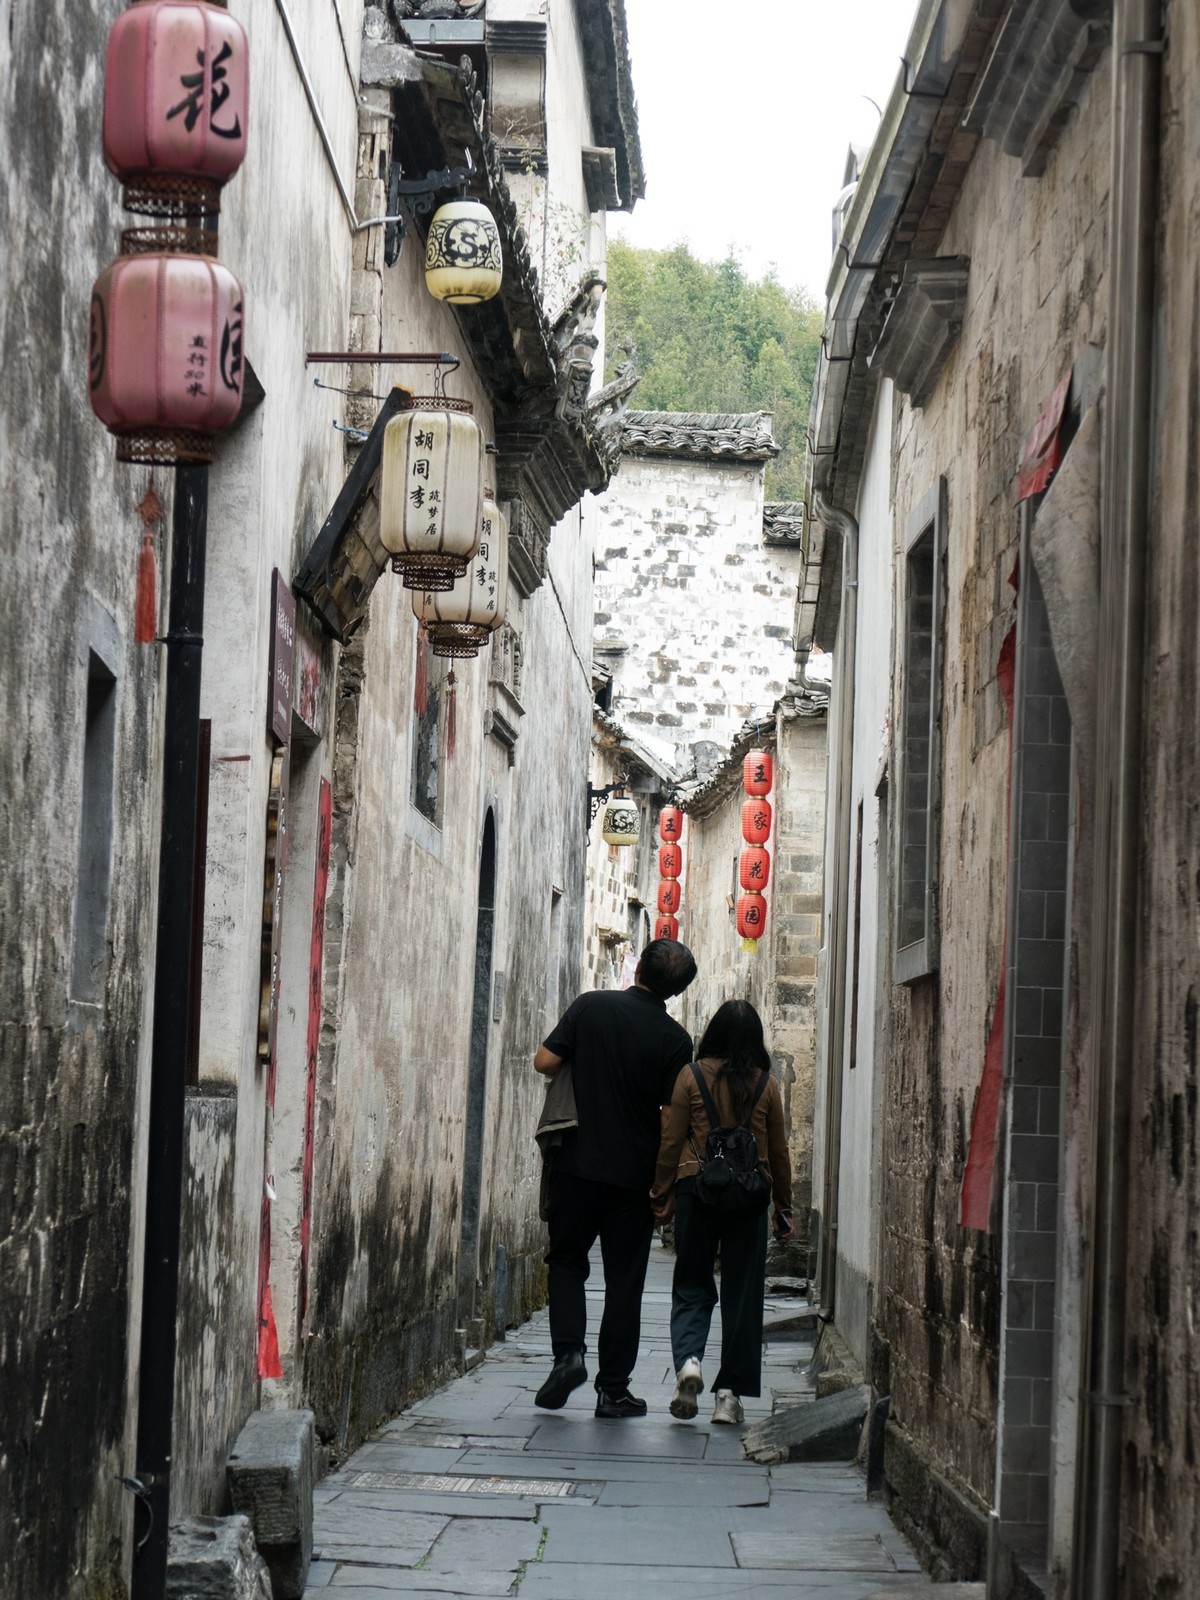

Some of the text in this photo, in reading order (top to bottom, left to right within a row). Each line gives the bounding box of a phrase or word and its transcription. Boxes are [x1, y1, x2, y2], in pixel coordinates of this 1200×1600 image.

[166, 39, 242, 138] 花
[410, 429, 434, 509] 胡同李
[425, 489, 442, 535] 筑梦居
[476, 517, 492, 586] 胡同李
[486, 571, 497, 611] 筑梦居
[660, 817, 677, 940] 王家花园
[745, 764, 768, 925] 王家花园
